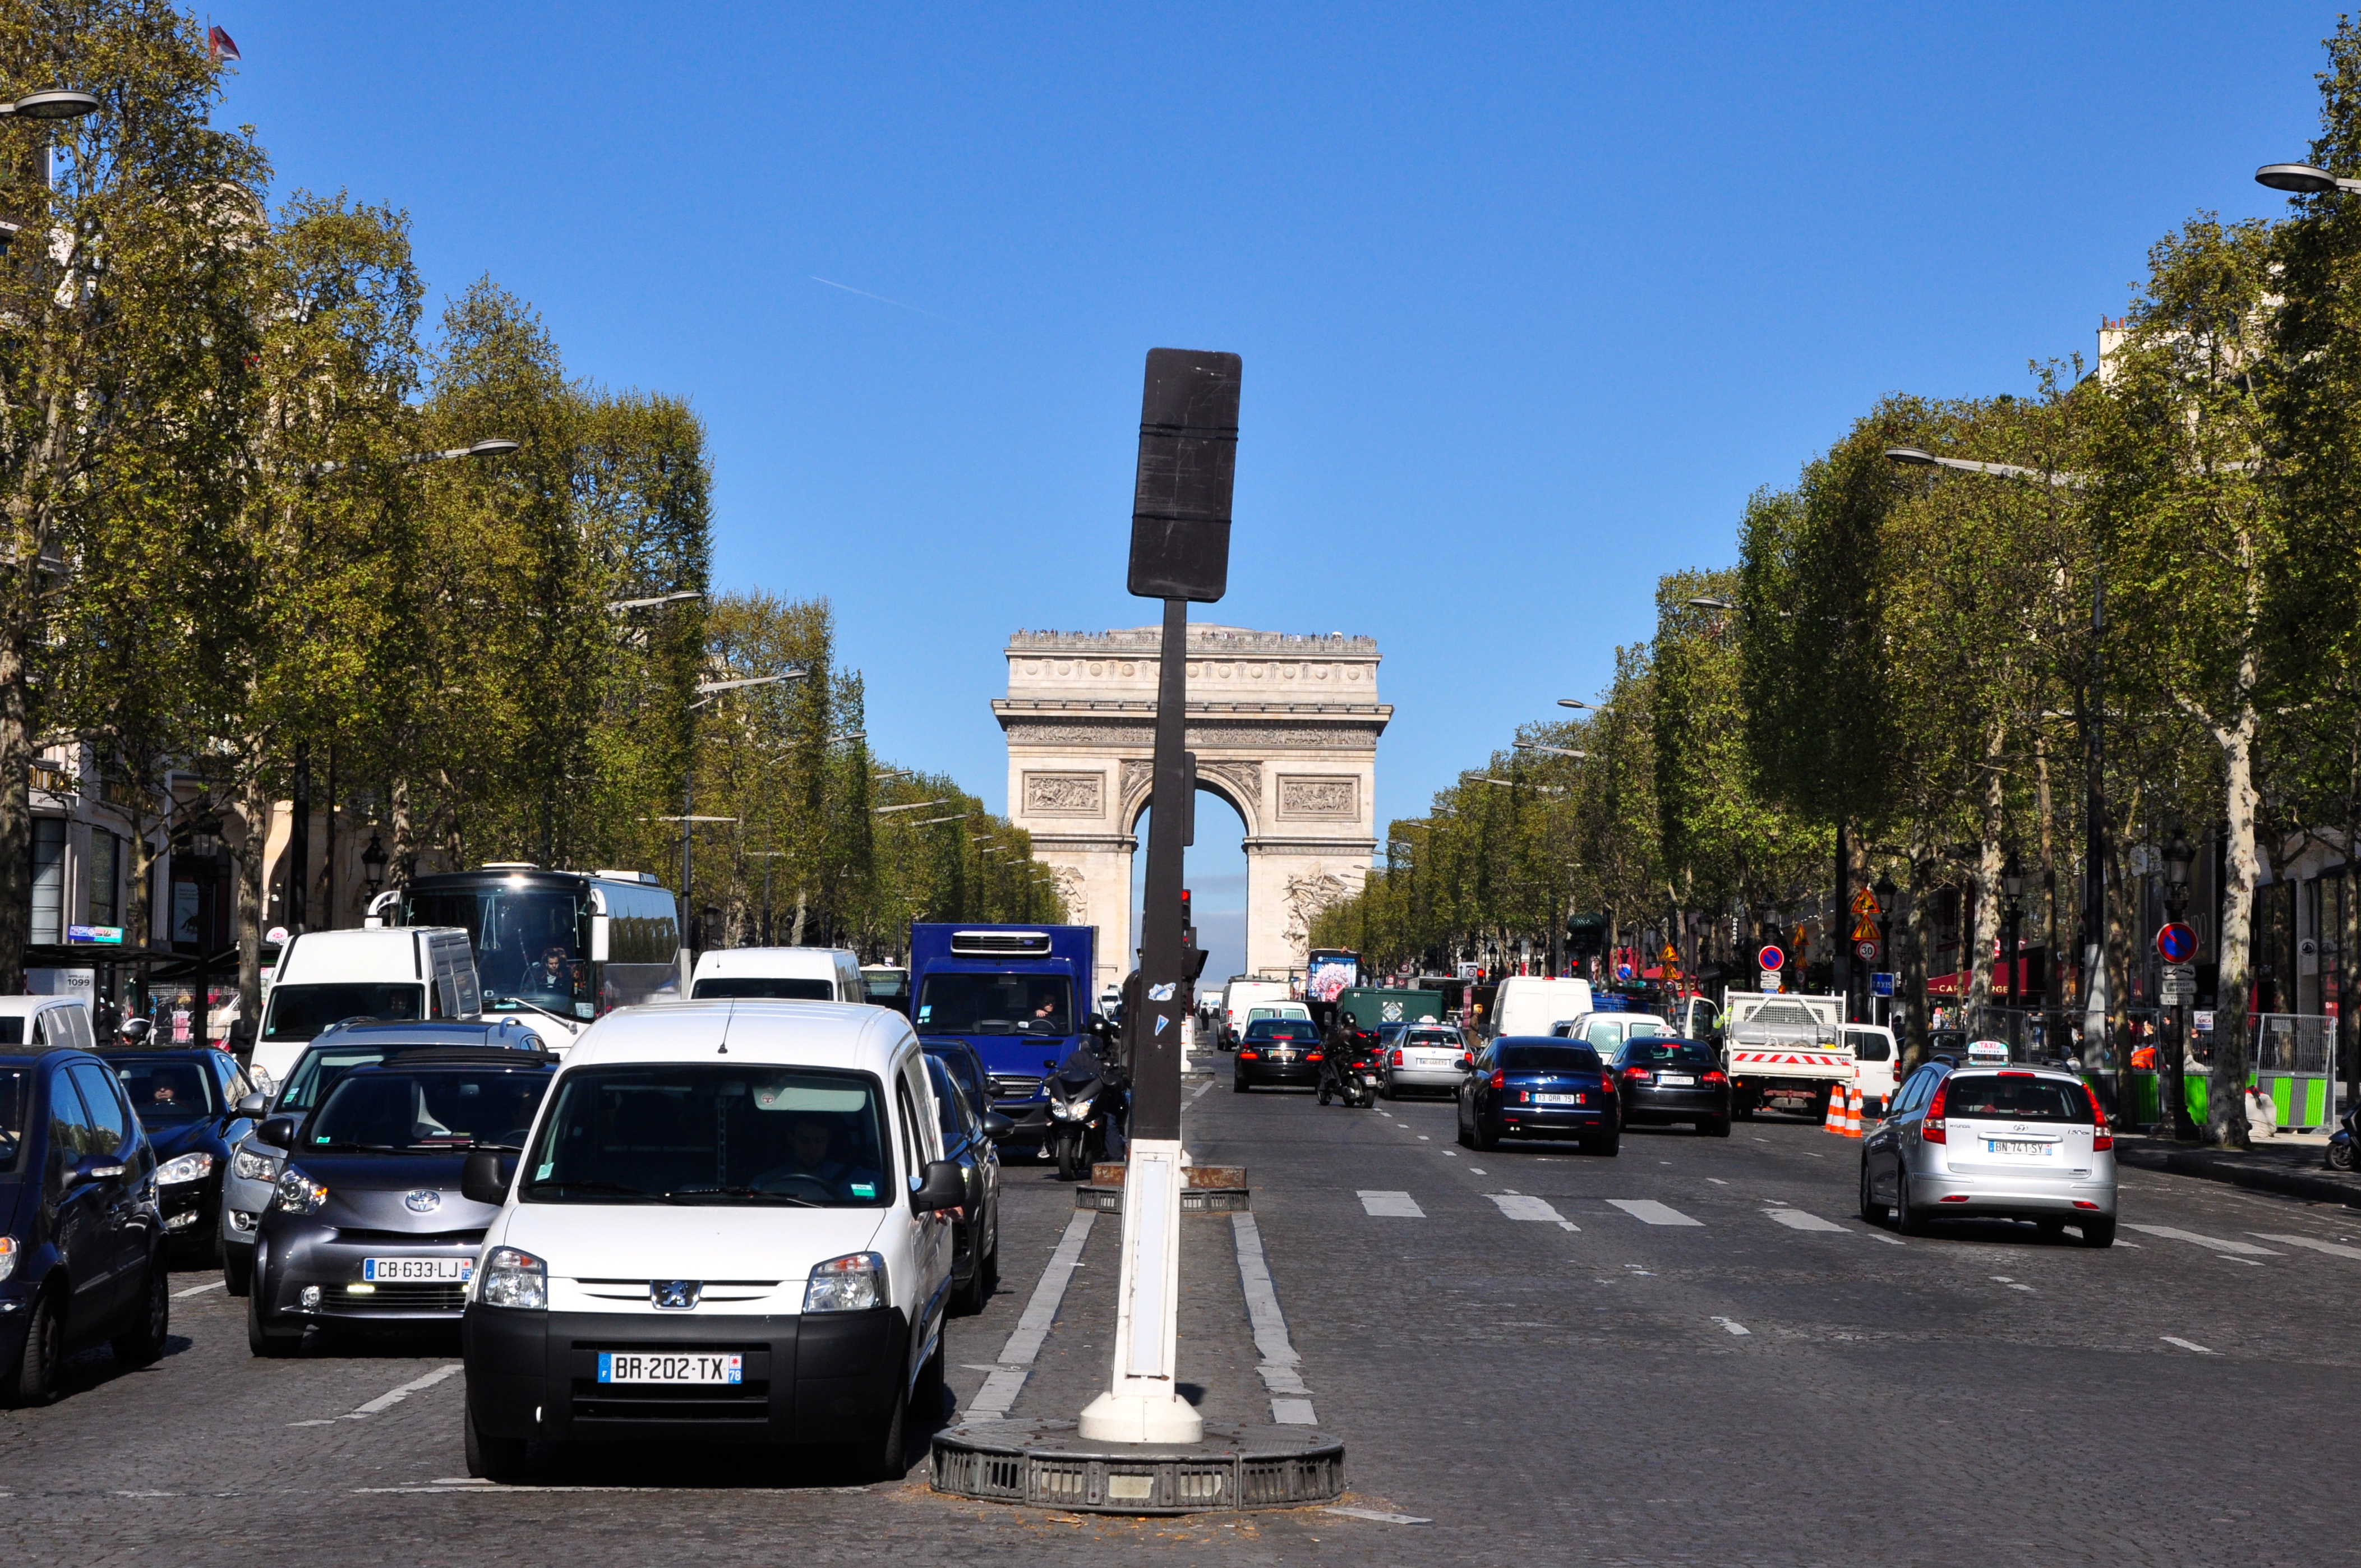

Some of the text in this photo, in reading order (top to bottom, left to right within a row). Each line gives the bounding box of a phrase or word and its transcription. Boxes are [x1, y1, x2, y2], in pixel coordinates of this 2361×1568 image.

[1861, 946, 1873, 955] 30
[378, 1261, 458, 1278] CB-633-LJ
[462, 1269, 472, 1279] 75
[615, 1357, 724, 1381] BR-202-TX
[728, 1369, 742, 1382] 78
